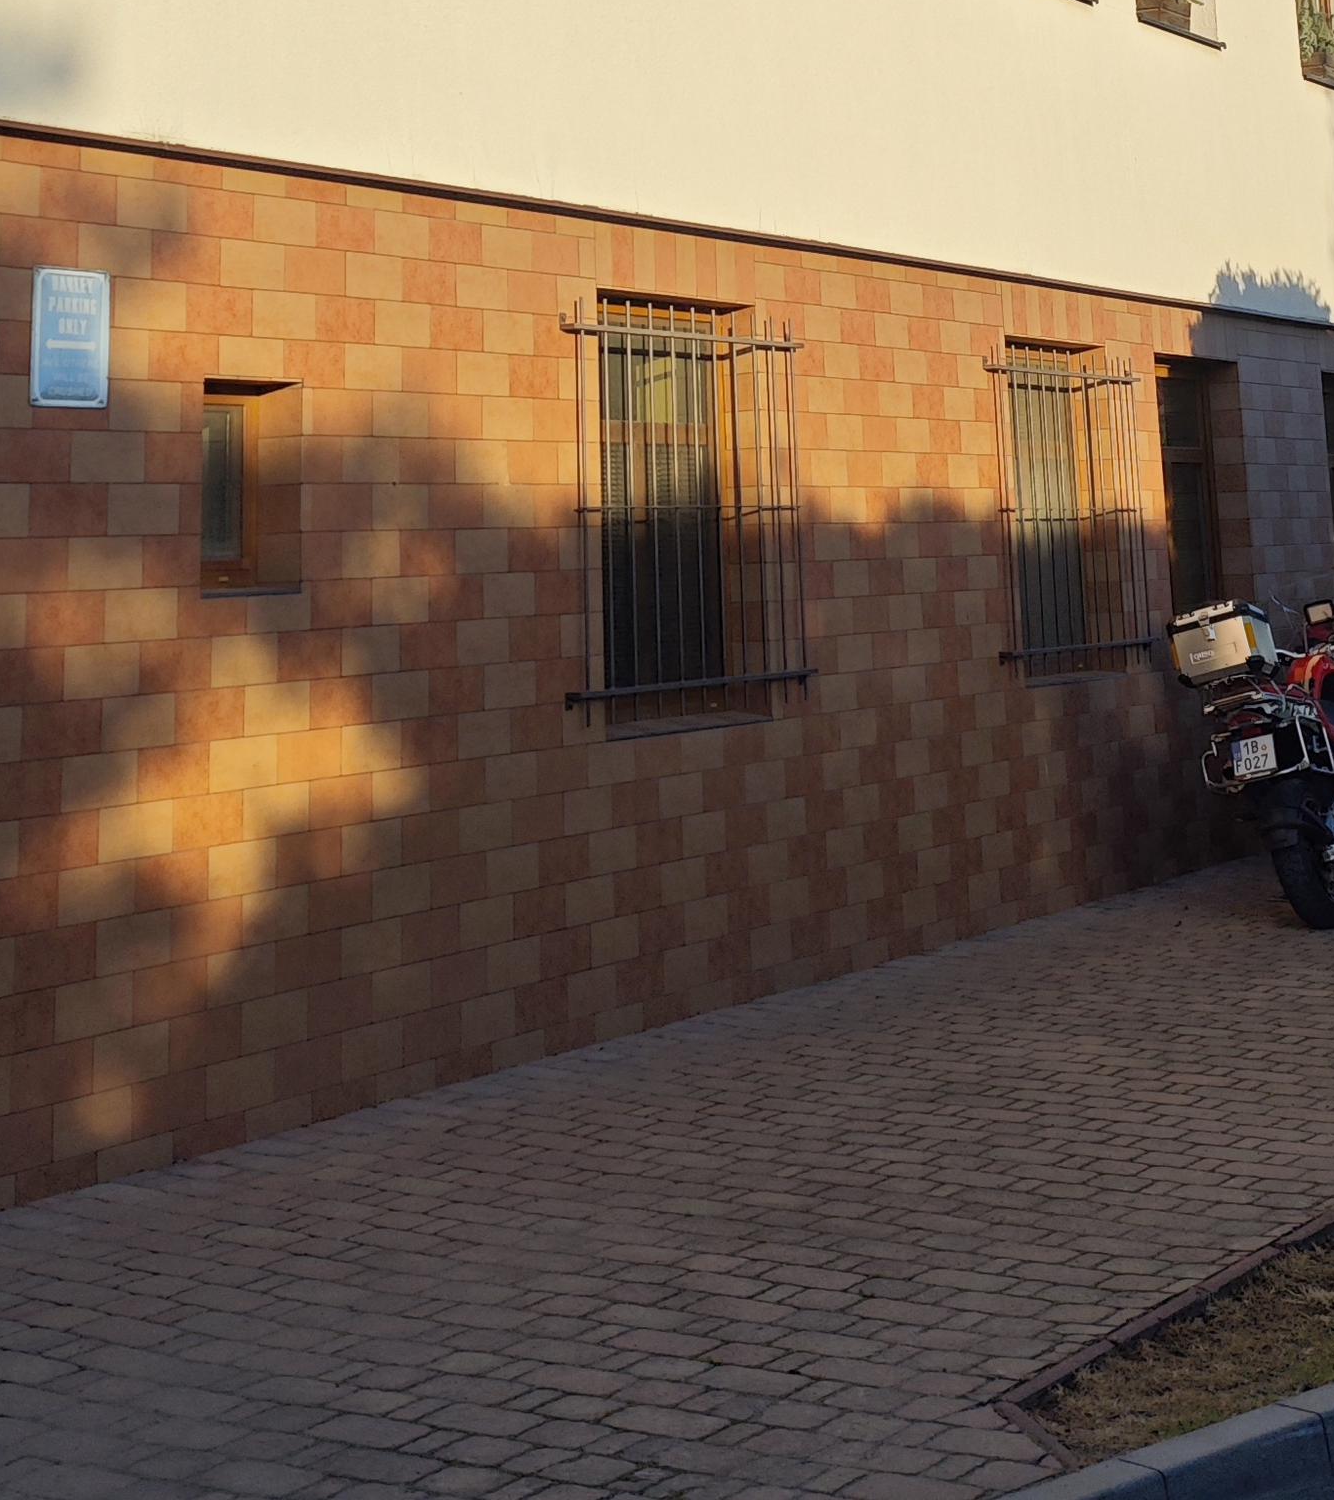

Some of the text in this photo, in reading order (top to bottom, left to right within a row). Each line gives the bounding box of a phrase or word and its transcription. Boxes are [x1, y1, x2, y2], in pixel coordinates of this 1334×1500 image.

[47, 296, 98, 315] PARKING
[58, 318, 87, 335] ONLY
[1242, 740, 1259, 756] 1B
